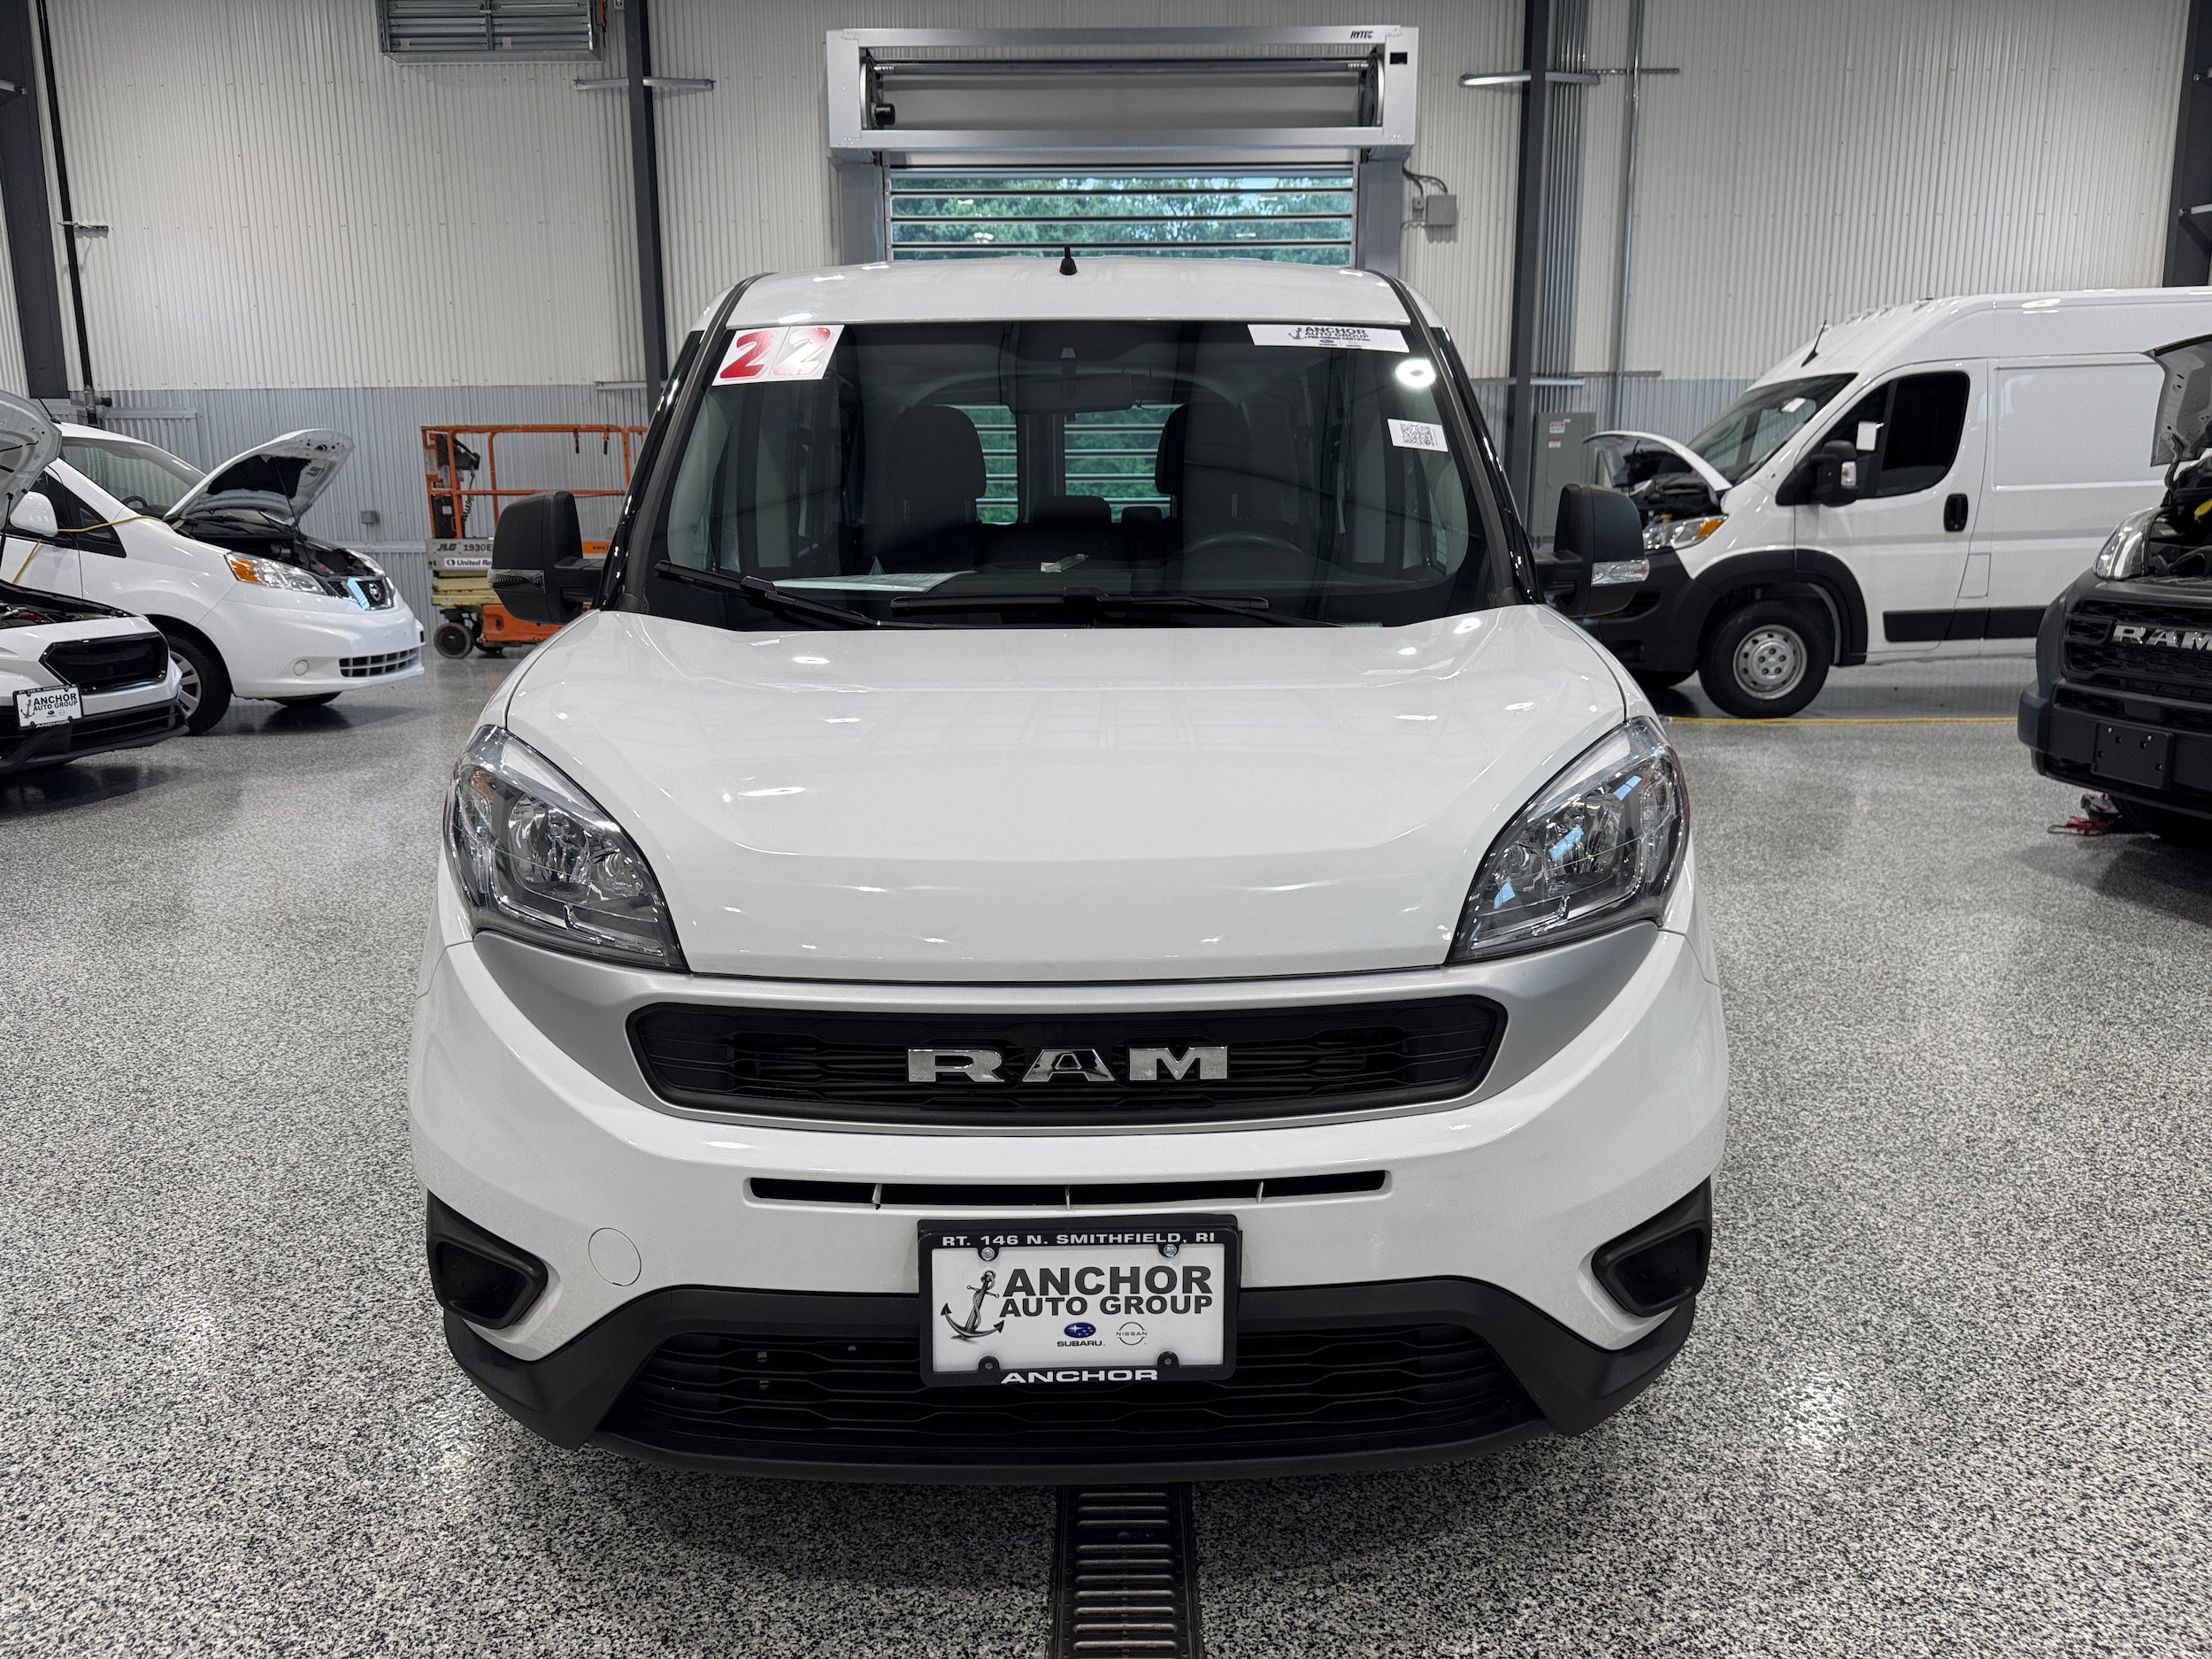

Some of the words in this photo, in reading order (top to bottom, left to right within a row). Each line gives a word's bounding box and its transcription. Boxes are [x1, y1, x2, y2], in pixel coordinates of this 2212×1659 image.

[1350, 30, 1373, 39] RYTEC
[2112, 625, 2212, 650] RAM
[34, 693, 77, 706] ANCHOR
[55, 700, 78, 709] GROUP
[35, 719, 70, 728] ANCHOR
[908, 1046, 1228, 1082] RAM
[942, 1236, 971, 1247] RT.
[980, 1235, 1018, 1246] 146
[1026, 1234, 1048, 1245] N.
[1056, 1233, 1187, 1245] SMITHFIELD,
[1195, 1233, 1215, 1243] RI
[1002, 1265, 1214, 1297] ANCHOR
[999, 1296, 1088, 1317] AUTO
[1100, 1294, 1213, 1316] GROUP
[1001, 1369, 1158, 1385] ANCHOR
